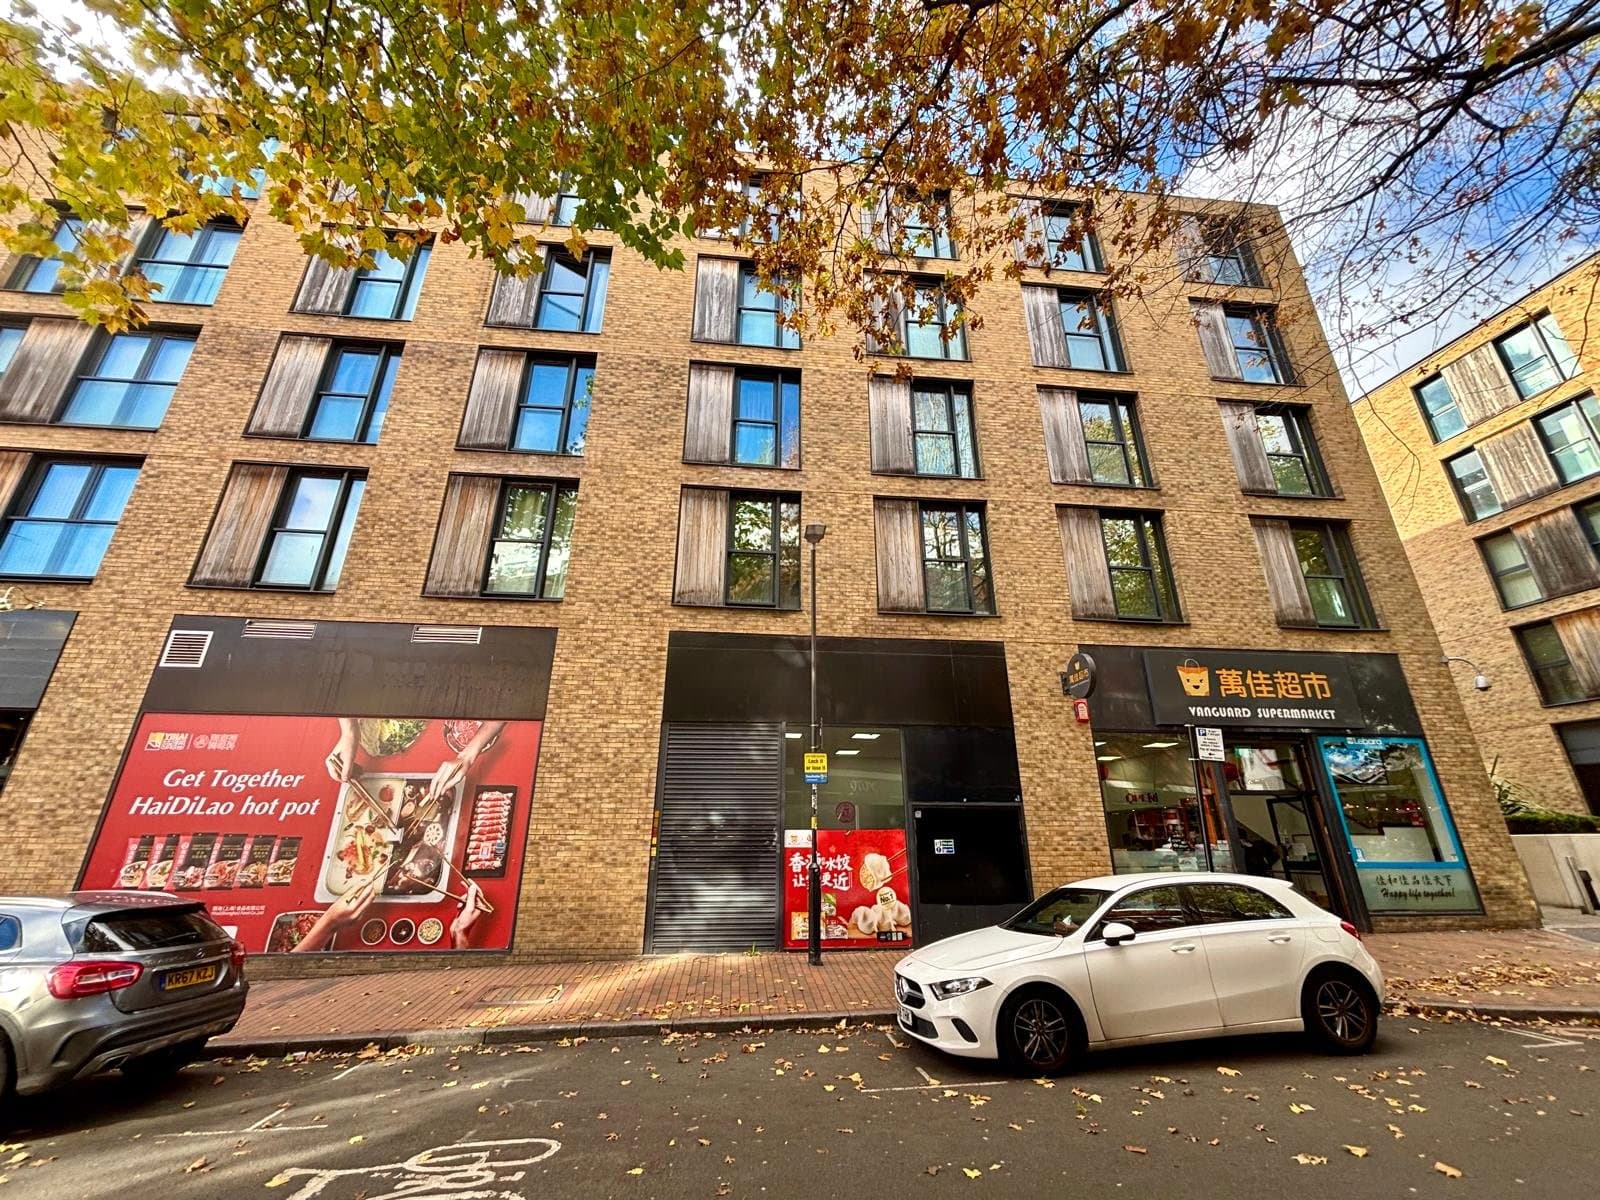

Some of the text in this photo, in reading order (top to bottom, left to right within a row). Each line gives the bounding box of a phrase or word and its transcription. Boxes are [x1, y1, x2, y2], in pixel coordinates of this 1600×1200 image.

[1215, 668, 1332, 699] 萬佳超市
[1188, 706, 1336, 720] VANGUARD SUPERMARKET
[163, 768, 305, 793] Get Together
[128, 796, 321, 821] HaiDiLao hot pot
[791, 871, 850, 892] 让更近
[1381, 887, 1456, 901] Happy life together!
[167, 966, 214, 987] KR67 KZJ
